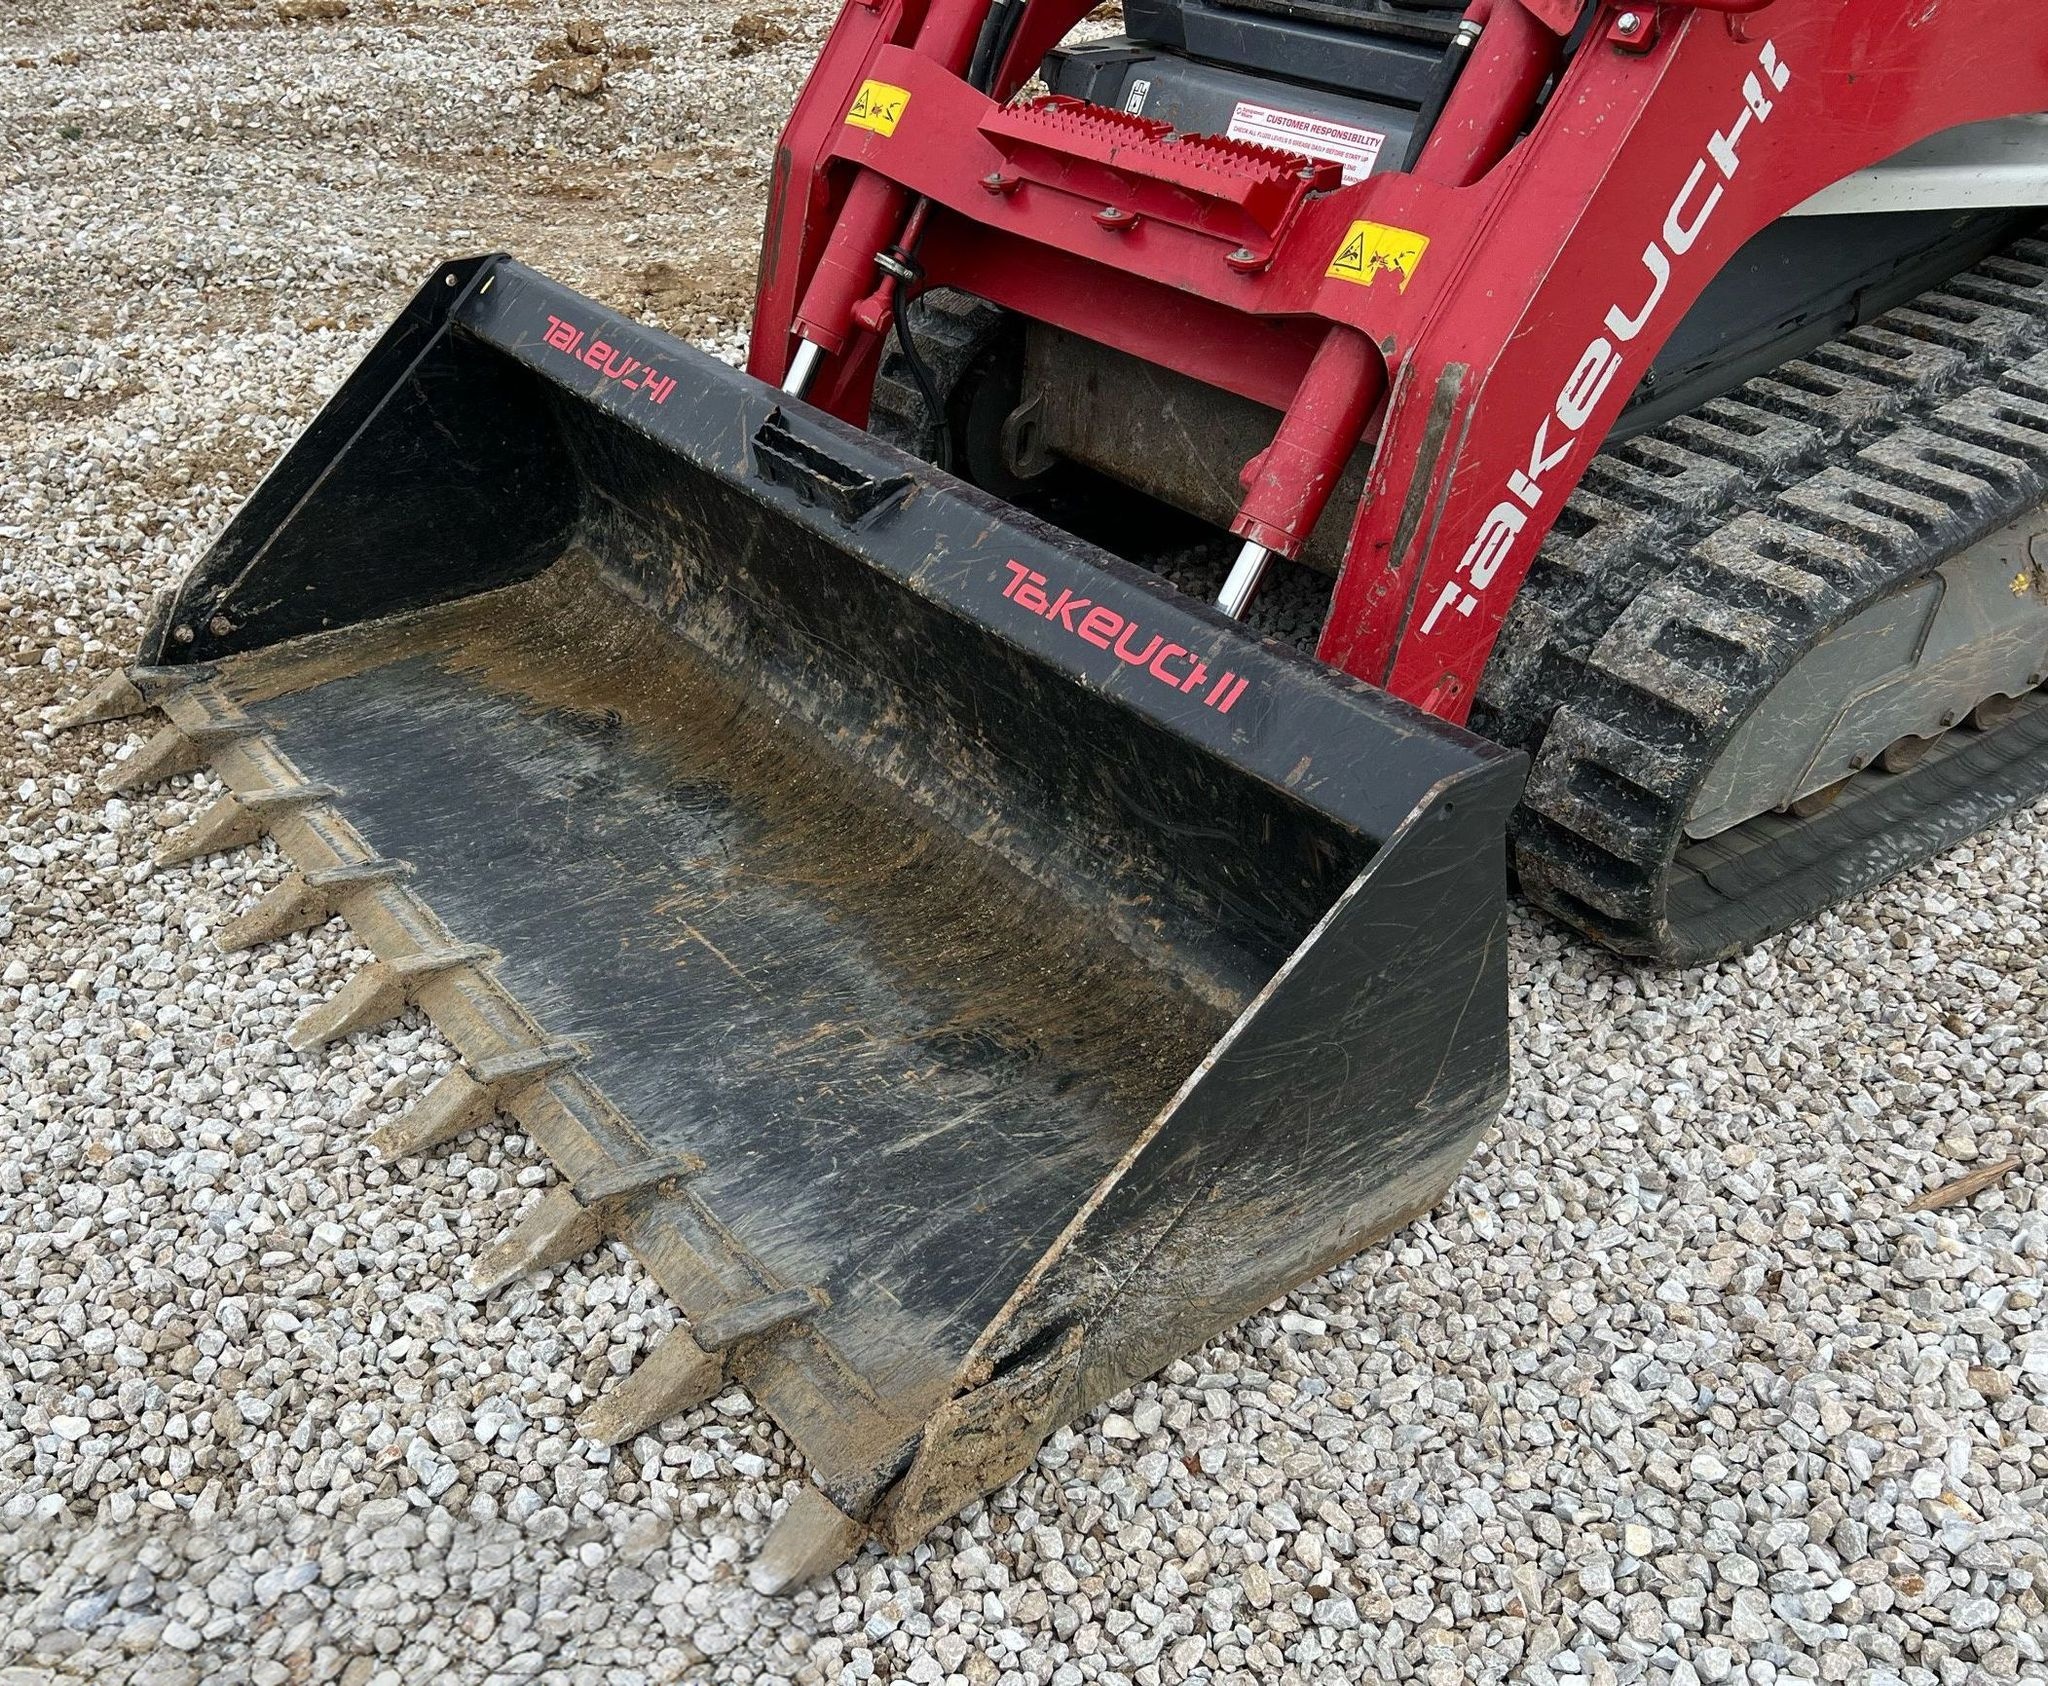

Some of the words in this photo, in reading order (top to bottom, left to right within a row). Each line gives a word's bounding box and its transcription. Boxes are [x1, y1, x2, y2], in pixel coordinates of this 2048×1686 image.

[1233, 125, 1249, 134] CHECK
[1271, 135, 1288, 144] LEVELS
[1325, 147, 1345, 157] BEFORE
[1345, 152, 1361, 161] START
[1266, 114, 1310, 132] CUSTOMER
[1310, 124, 1381, 147] RESPONSIBILITY
